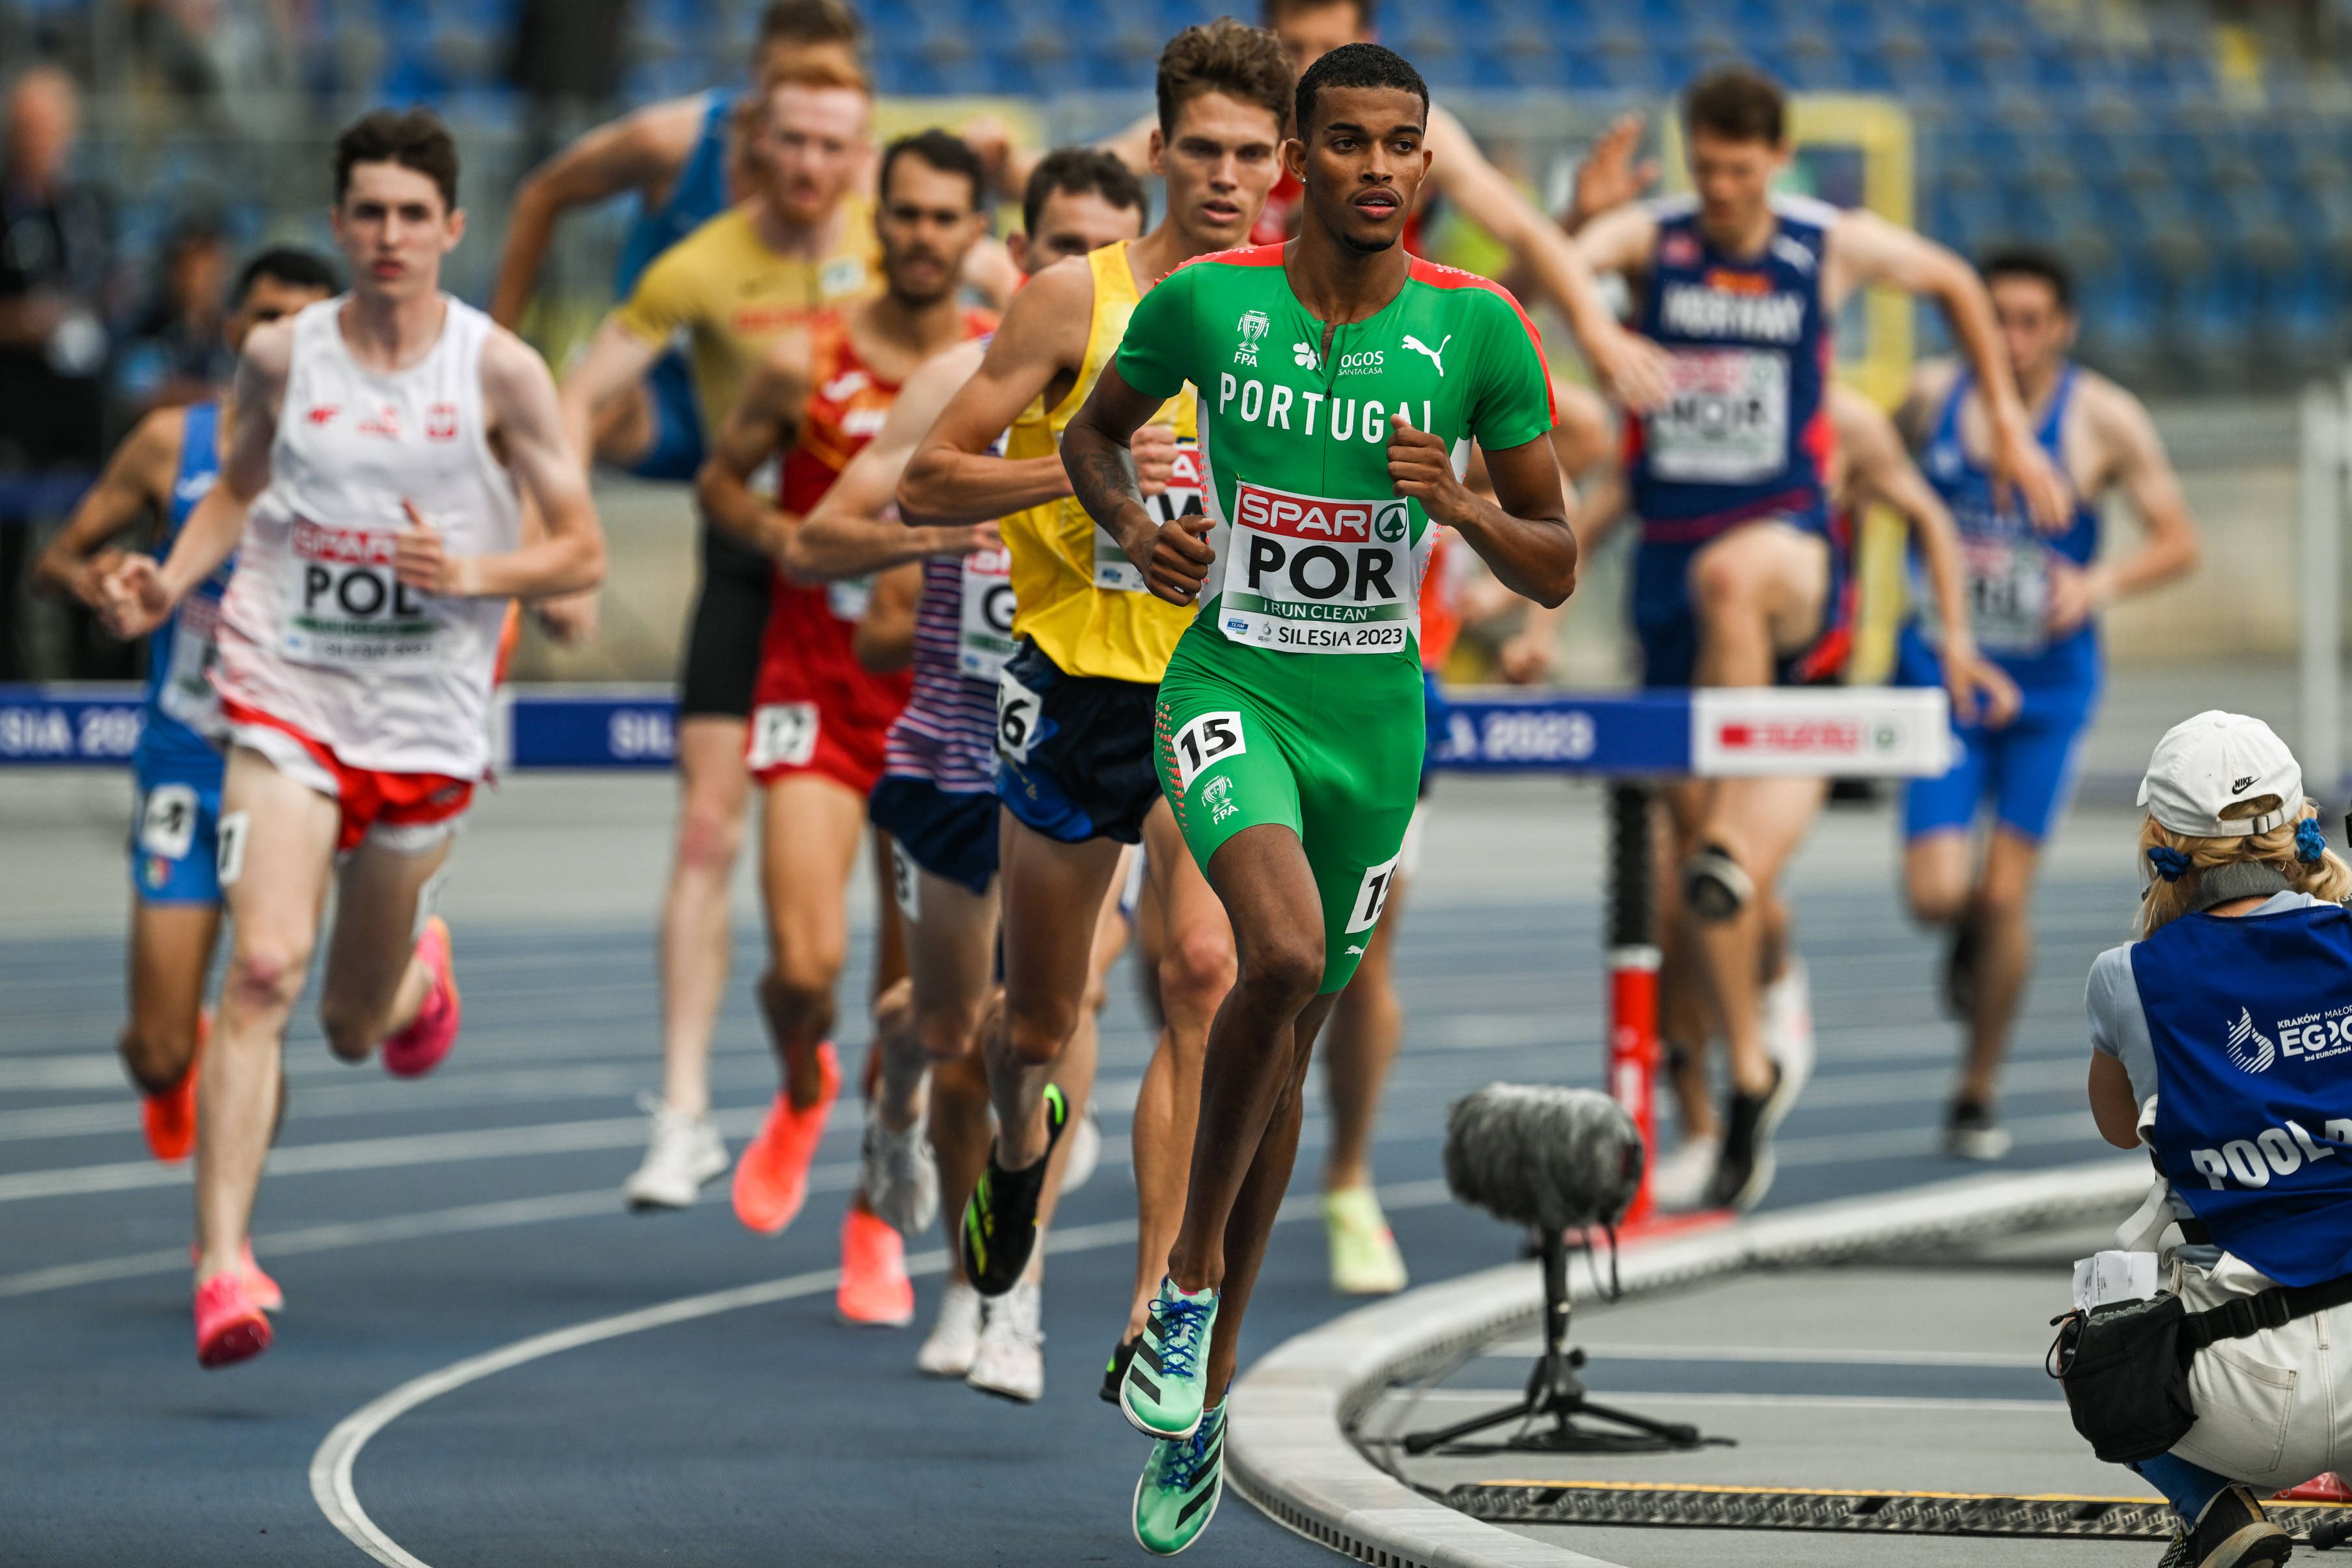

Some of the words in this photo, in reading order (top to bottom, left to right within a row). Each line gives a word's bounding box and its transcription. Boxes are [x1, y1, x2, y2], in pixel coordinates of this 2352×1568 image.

[1234, 351, 1258, 368] FPA
[1242, 493, 1368, 537] SPAR
[1248, 534, 1397, 601] POR
[305, 565, 422, 617] POL
[1271, 603, 1306, 618] RUN
[1278, 626, 1351, 646] SILESIA
[1356, 628, 1402, 646] 2023
[1181, 719, 1237, 773] 15
[2235, 776, 2252, 788] NIKE
[1213, 805, 1239, 825] FPA
[2277, 1013, 2321, 1029] KRAKÓW
[2316, 1045, 2351, 1060] EUROPEAN
[2191, 1120, 2335, 1190] POOL
